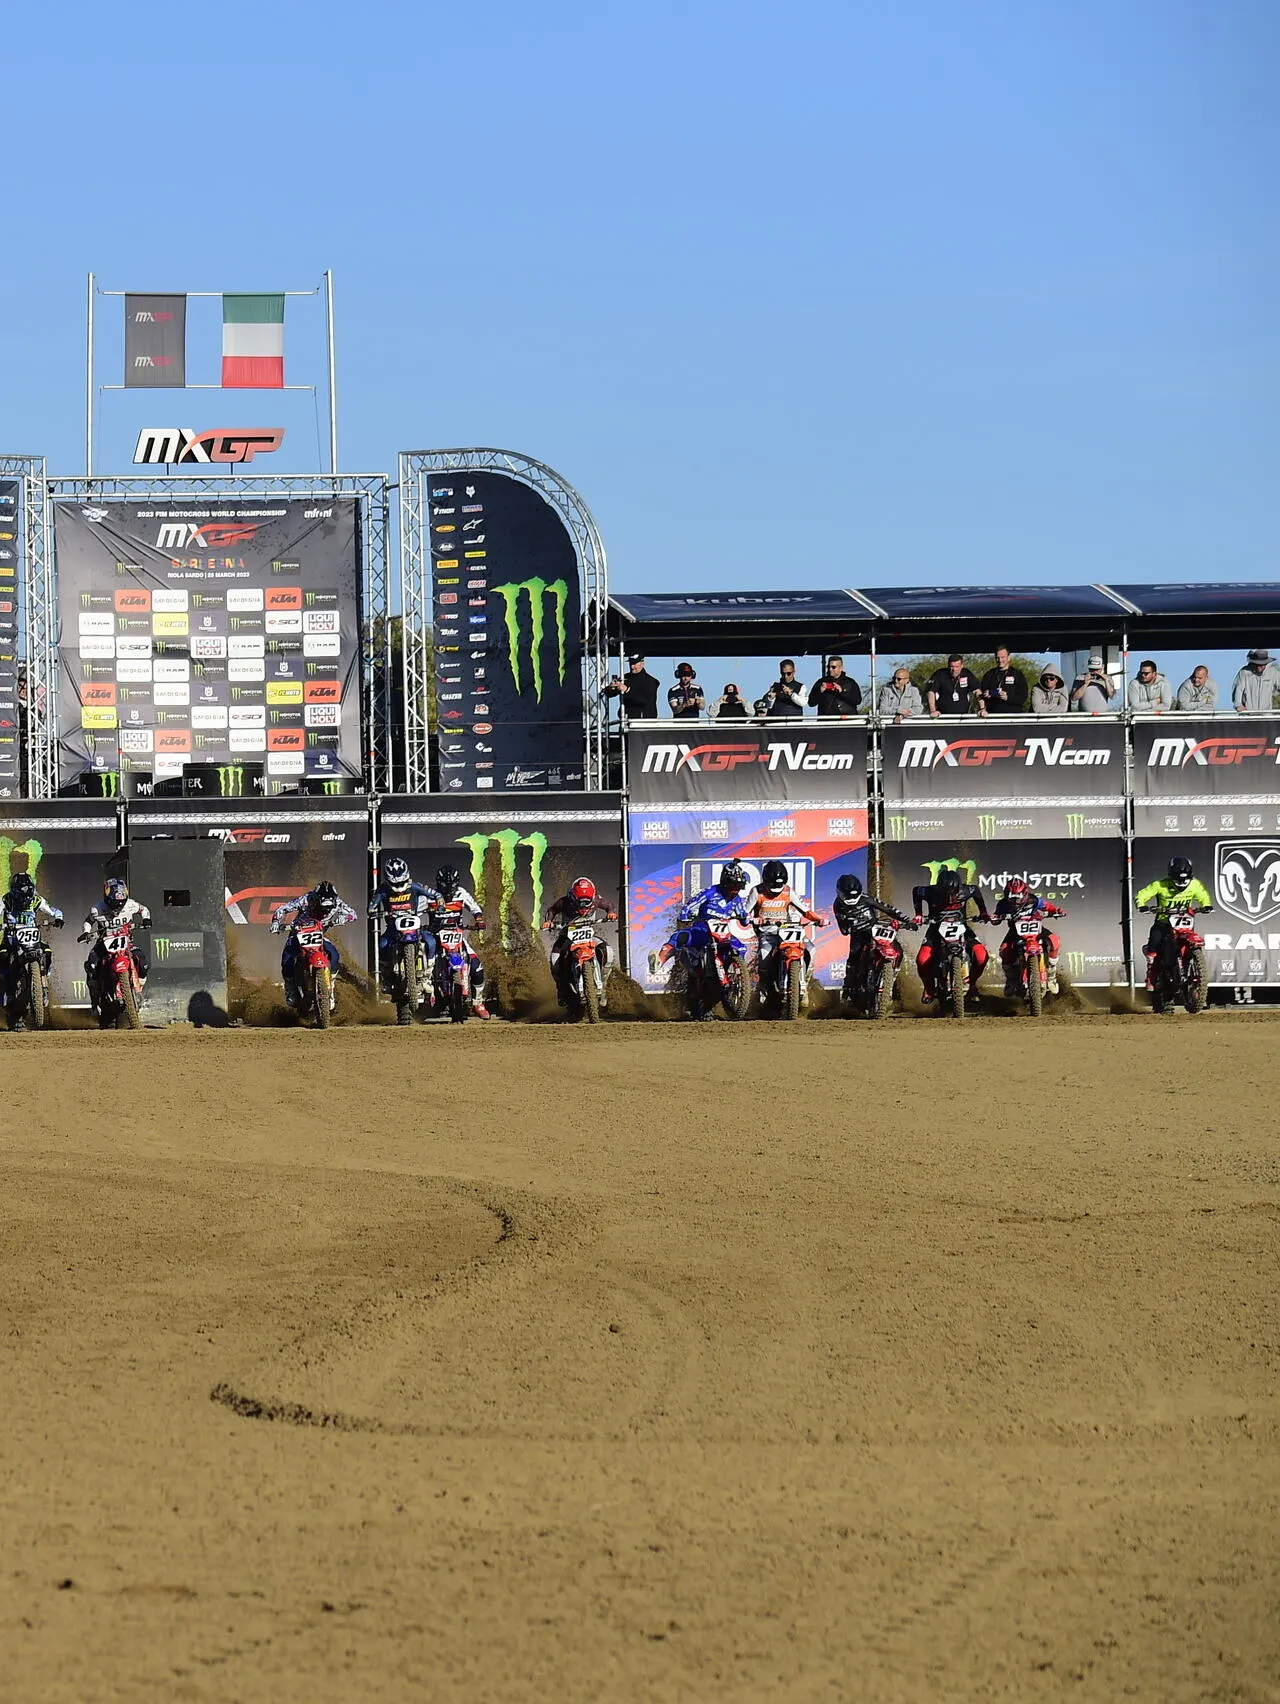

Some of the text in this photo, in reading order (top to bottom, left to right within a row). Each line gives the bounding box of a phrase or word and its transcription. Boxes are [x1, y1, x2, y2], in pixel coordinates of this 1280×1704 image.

[133, 428, 286, 466] MXGP
[169, 510, 210, 518] MOTOCROSS
[236, 509, 287, 517] CHAMPIONSHIP
[156, 523, 260, 550] MXGP
[270, 594, 297, 603] KTM
[86, 689, 112, 699] KTM
[309, 687, 337, 697] KTM
[273, 735, 299, 744] KTM
[643, 822, 669, 830] LIQUI
[702, 820, 728, 829] LIQUI
[769, 819, 795, 828] LIQUI
[829, 818, 854, 827] LIQUI
[643, 831, 669, 839] MOLY
[702, 830, 728, 838] MOLY
[769, 829, 795, 837] MOLY
[829, 828, 854, 836] MOLY
[400, 917, 415, 928] 6
[1174, 916, 1191, 926] 75
[712, 923, 728, 933] 77
[945, 926, 959, 938] 2
[1020, 923, 1038, 933] 92
[18, 931, 40, 944] 259
[300, 932, 323, 945] 32
[442, 933, 462, 943] 919
[572, 929, 592, 941] 226
[784, 930, 802, 941] 71
[108, 937, 126, 951] 41
